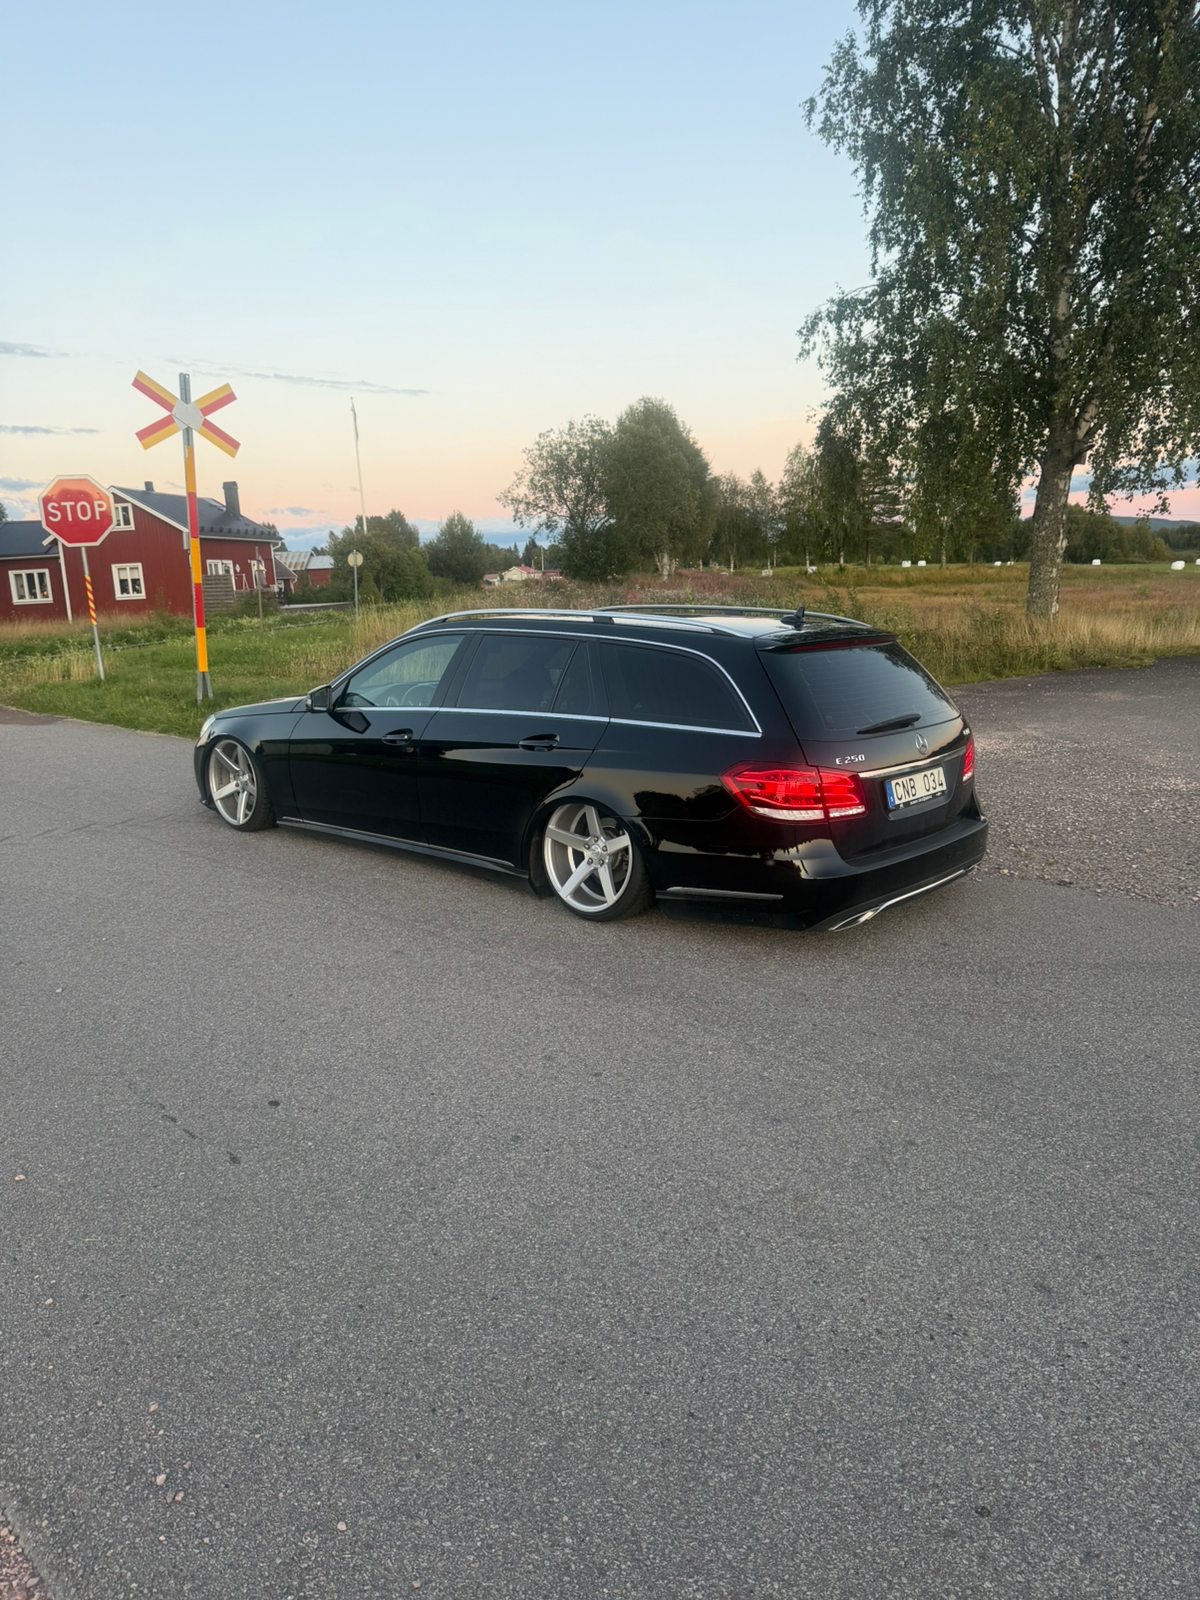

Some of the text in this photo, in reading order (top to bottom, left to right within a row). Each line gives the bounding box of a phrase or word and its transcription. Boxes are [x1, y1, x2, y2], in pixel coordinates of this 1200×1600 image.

[47, 501, 107, 522] STOP
[835, 753, 865, 765] E 250
[894, 777, 917, 801] CNB
[923, 769, 943, 792] 034
